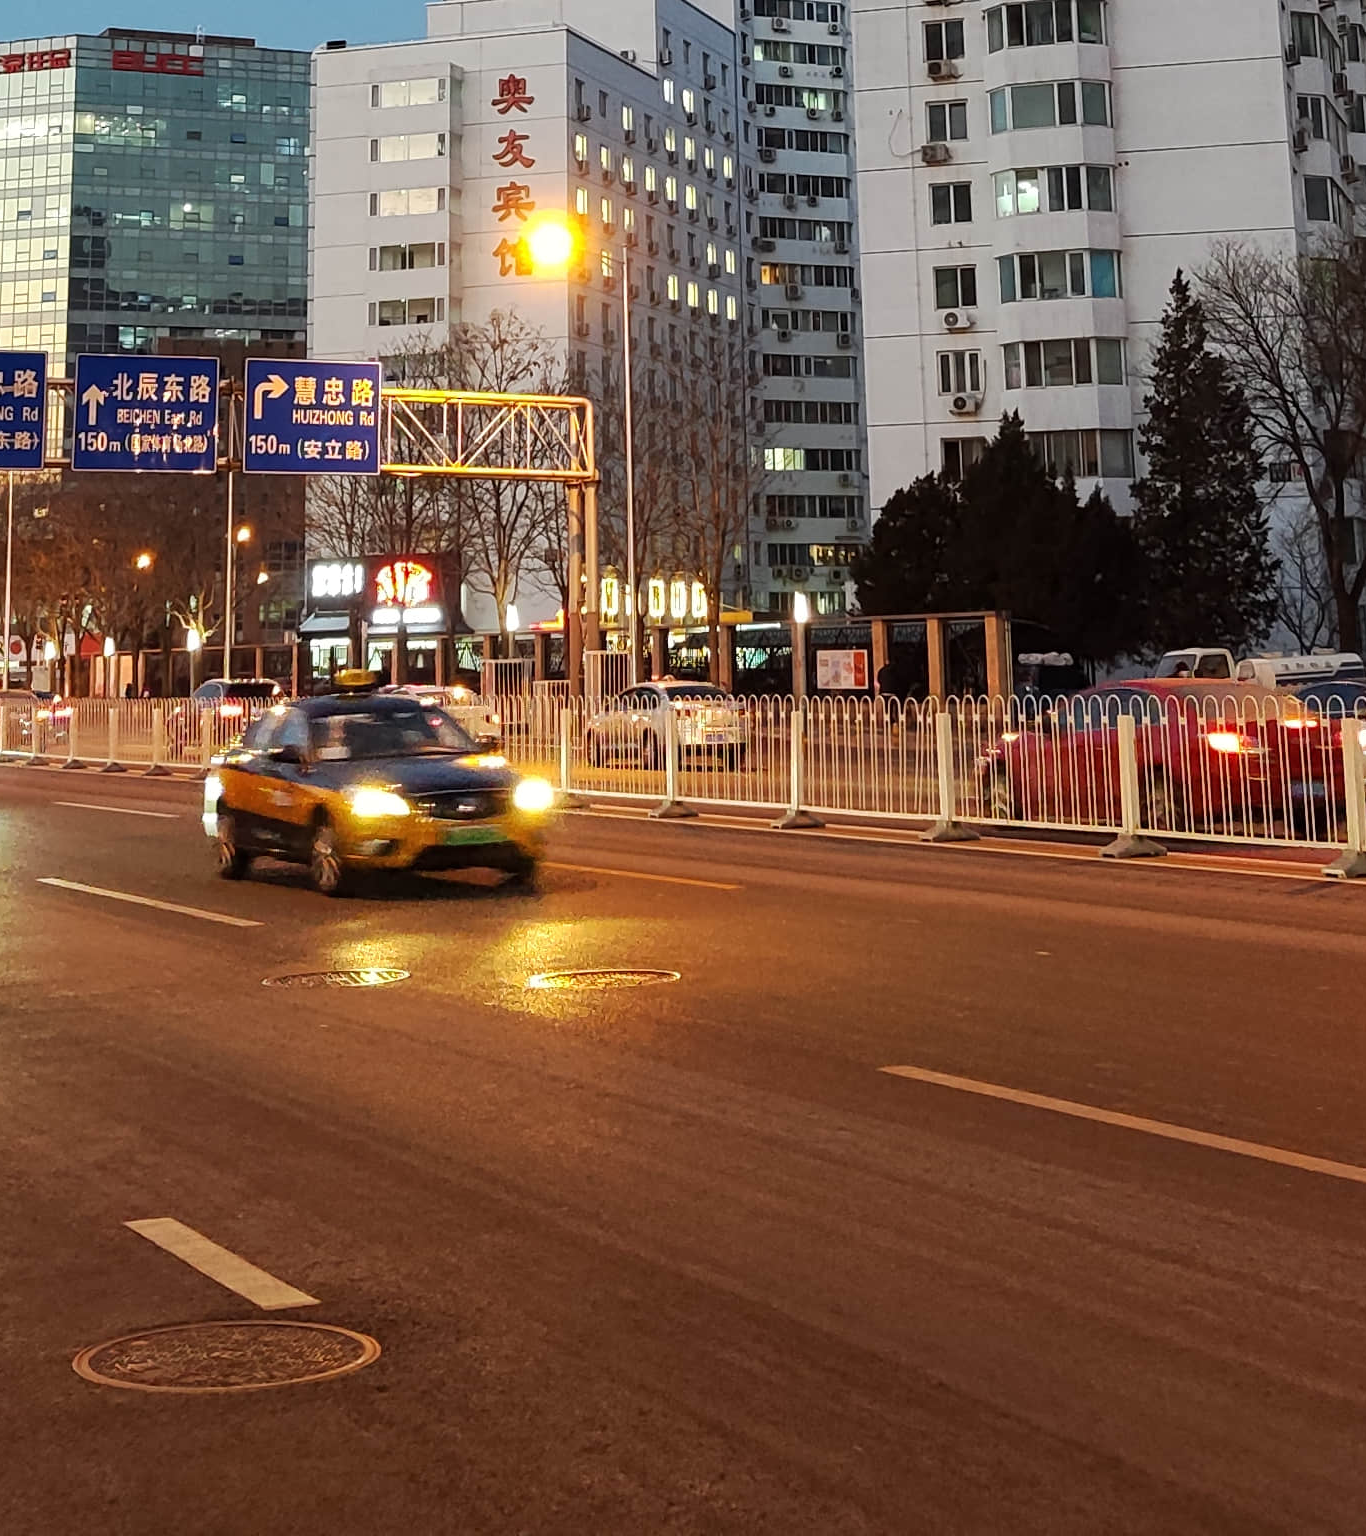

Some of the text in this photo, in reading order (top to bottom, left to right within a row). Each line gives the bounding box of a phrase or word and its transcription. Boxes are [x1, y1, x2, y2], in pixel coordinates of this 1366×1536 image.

[491, 73, 536, 277] 奥友宾馆
[112, 372, 212, 403] 北辰东路
[293, 376, 375, 407] 慧忠路
[22, 406, 39, 422] Rd
[116, 408, 161, 425] BEICHEN
[190, 410, 203, 425] Rd
[292, 409, 375, 426] HUIZHONG Rd
[78, 432, 121, 452] 150m
[248, 434, 291, 455] 150m
